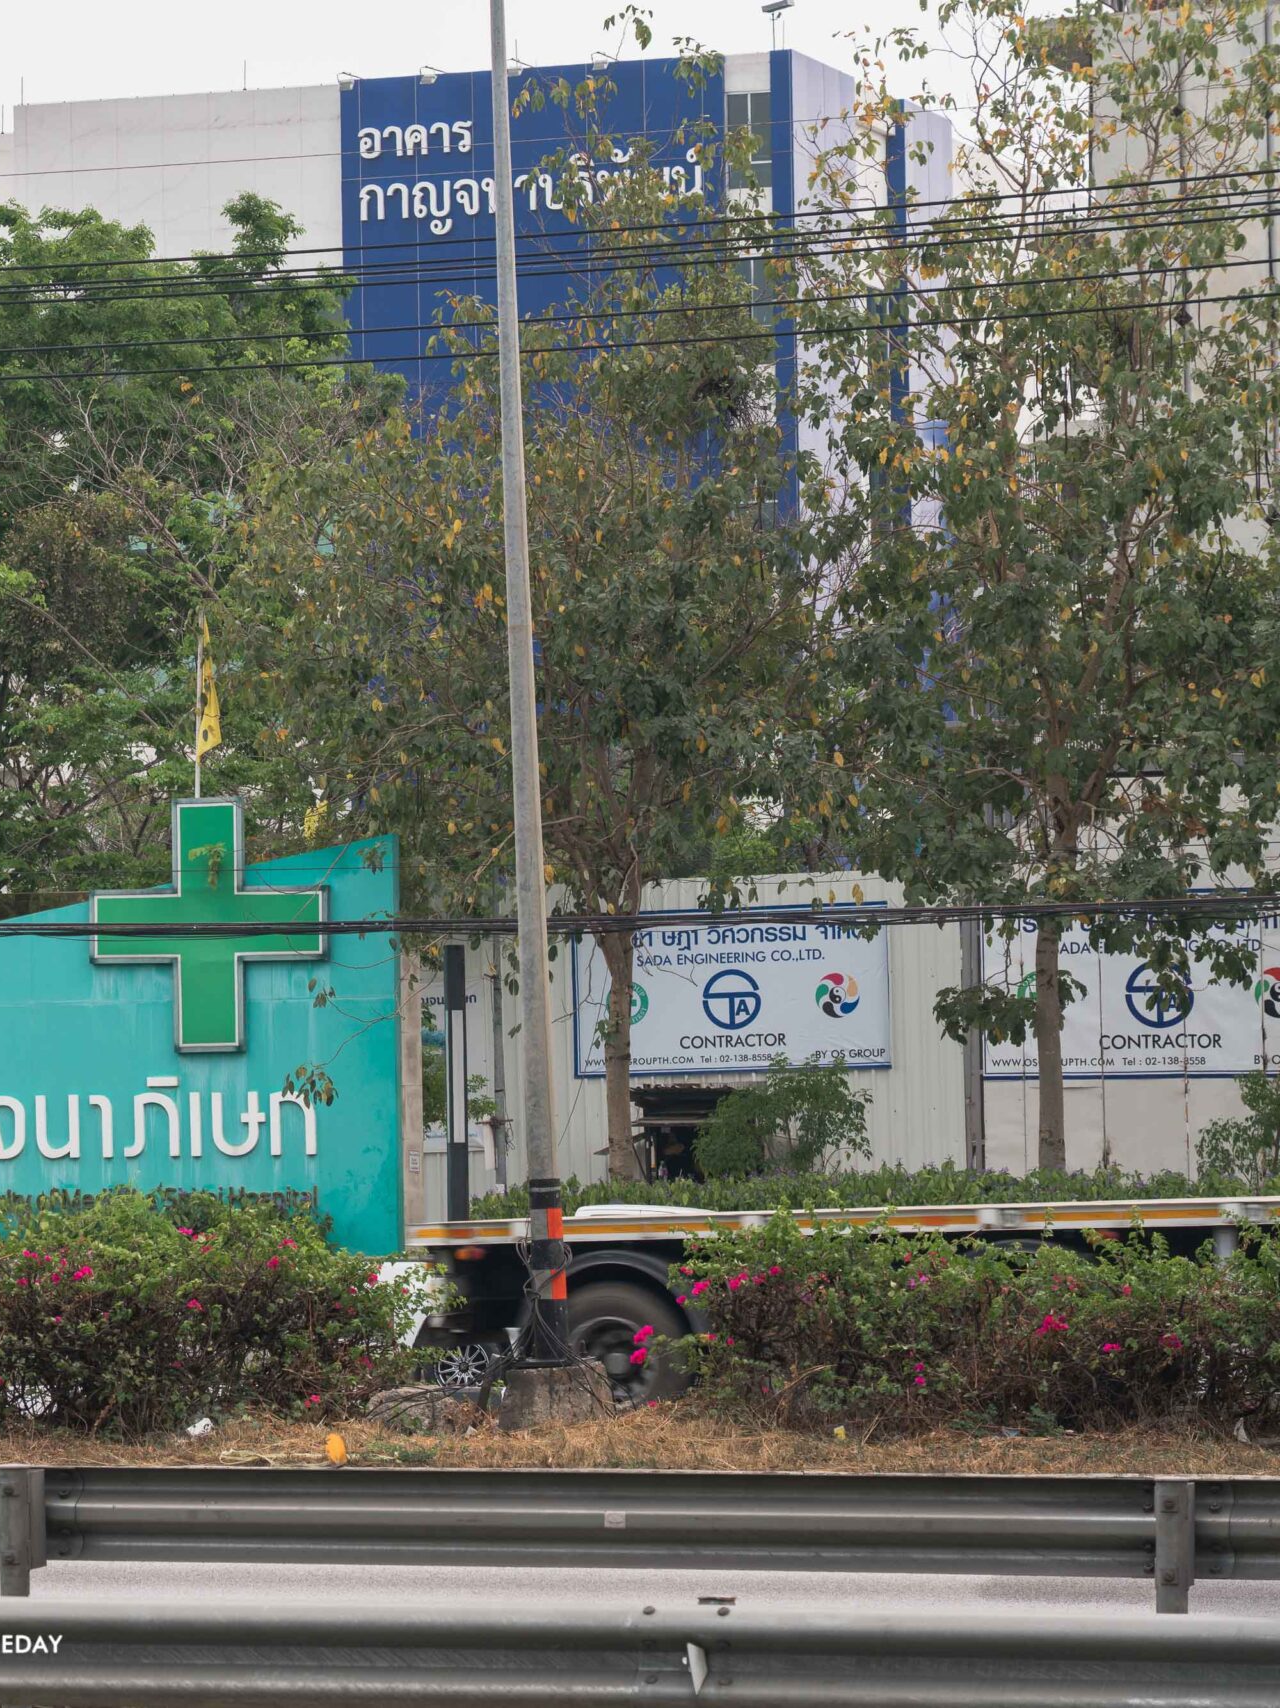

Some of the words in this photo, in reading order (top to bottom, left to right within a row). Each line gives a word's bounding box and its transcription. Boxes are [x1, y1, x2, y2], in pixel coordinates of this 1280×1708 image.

[358, 120, 473, 159] อาคาร
[1059, 942, 1091, 954] ADA
[637, 953, 672, 967] SADA
[677, 950, 766, 966] ENGINEERING
[771, 948, 825, 962] CO.,LTD.
[680, 1032, 787, 1049] CONTRACTOR
[1099, 1033, 1223, 1049] CONTRACTOR
[700, 1055, 712, 1064] Tel
[719, 1054, 772, 1063] 02-138-8558
[815, 1050, 828, 1059] BY
[831, 1049, 846, 1059] OS
[849, 1048, 886, 1058] GROUP
[991, 1057, 1115, 1067] WWW.OSUPTH.COM
[1122, 1057, 1136, 1066] Tel
[1145, 1056, 1206, 1066] 02-138-8558
